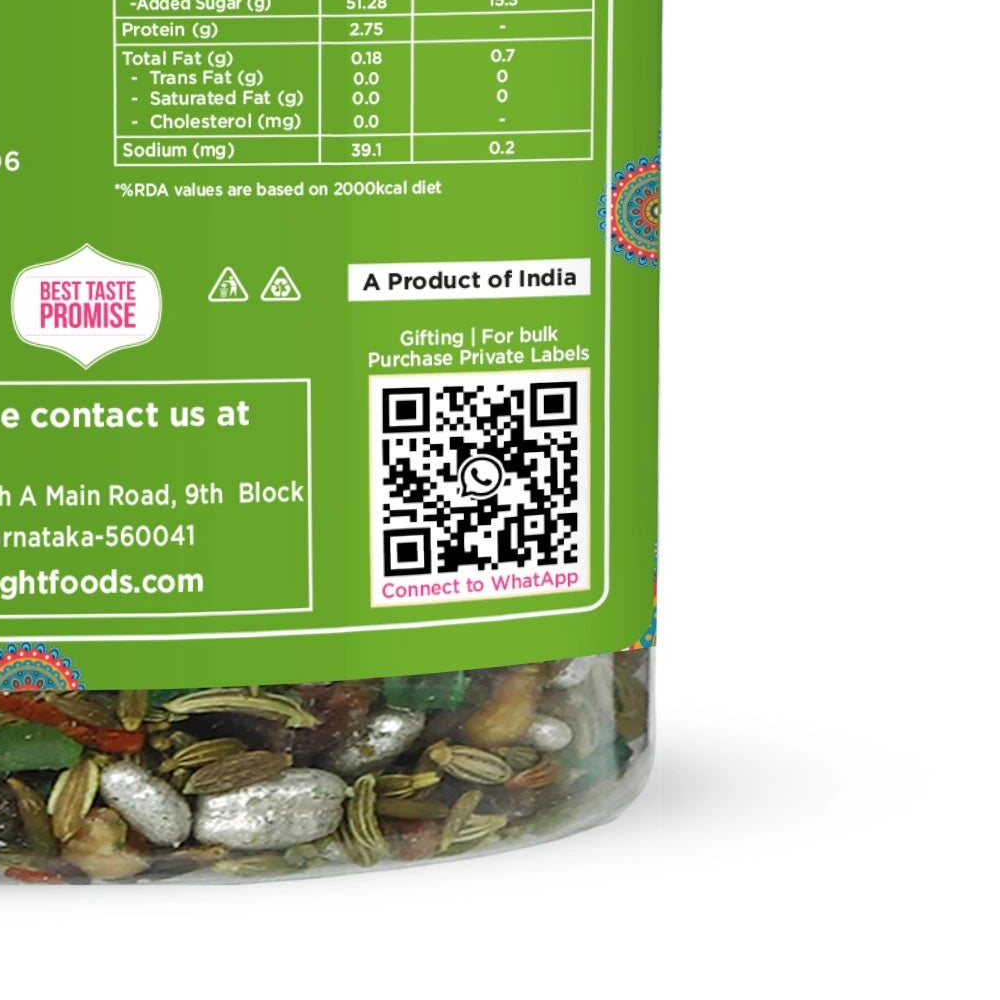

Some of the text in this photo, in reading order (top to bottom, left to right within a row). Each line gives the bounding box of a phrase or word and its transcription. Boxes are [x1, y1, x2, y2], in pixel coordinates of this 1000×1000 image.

[122, 22, 218, 39] Protein (g)
[350, 22, 383, 36] 2.75
[122, 51, 233, 68] Total Fat (g)
[351, 51, 382, 65] 0.18
[150, 70, 263, 87] Trans Fat (g)
[151, 90, 303, 107] Saturated Fat (g)
[151, 113, 301, 131] Cholesterol (mg)
[123, 142, 234, 160] Sodium (mg)
[352, 143, 381, 157] 39.1
[174, 183, 223, 196] values
[228, 185, 252, 196] are
[257, 182, 304, 196] based
[309, 185, 328, 195] on
[334, 181, 407, 196] 2000kcal
[412, 180, 441, 194] diet
[364, 269, 576, 290] A Product of India
[40, 281, 136, 301] BEST TASTE
[40, 302, 136, 328] PROMISE
[400, 326, 558, 348] Gifting For bulk
[369, 345, 589, 368] Purchase Private Labels
[31, 402, 158, 428] contact
[171, 406, 205, 427] us
[217, 401, 249, 426] at
[382, 572, 578, 598] Connect to WhatApp
